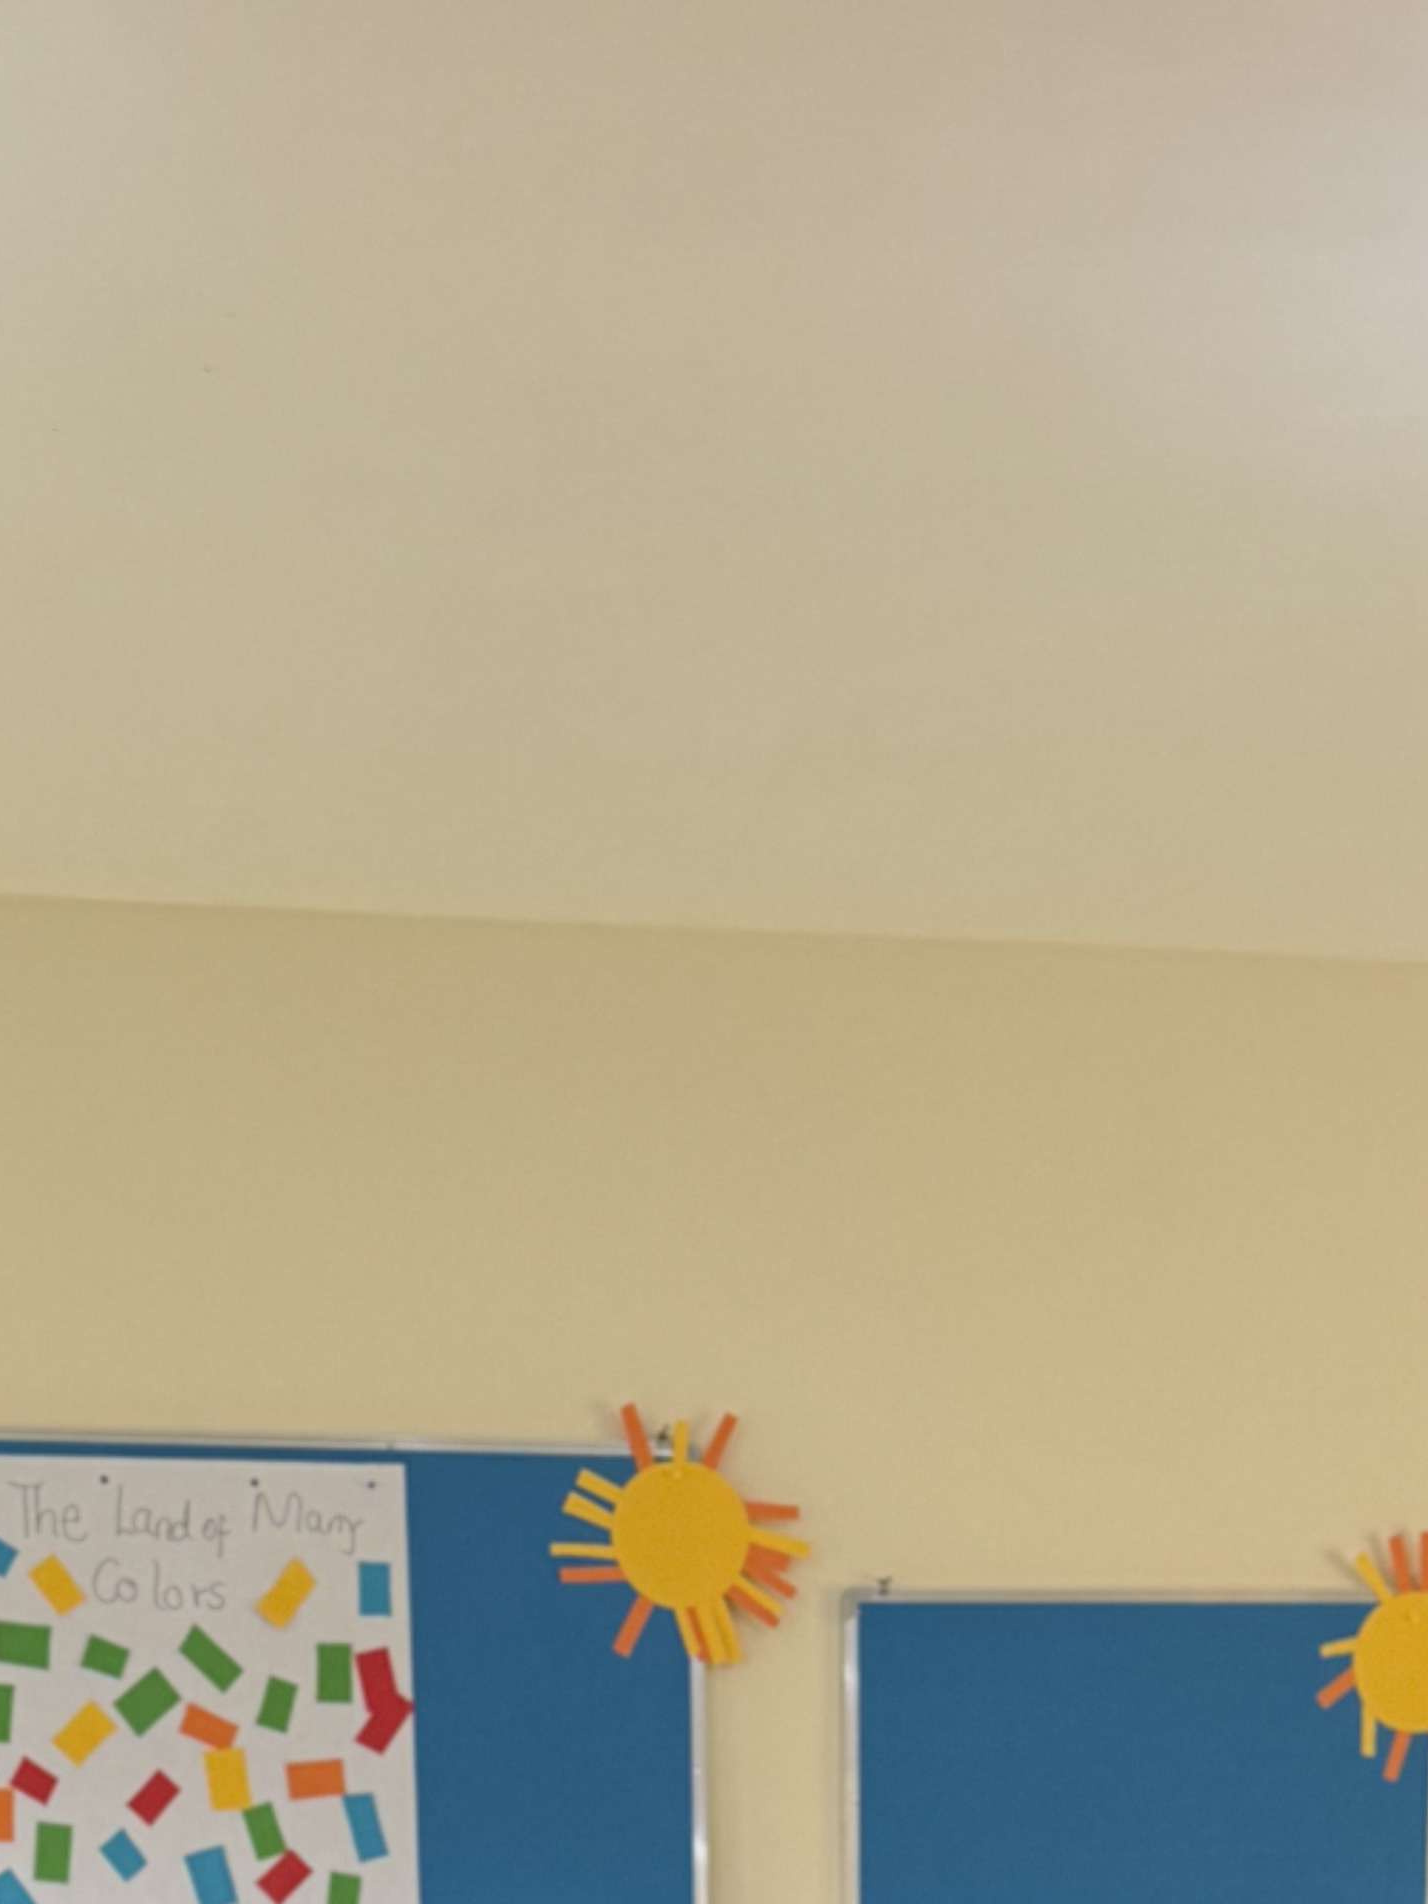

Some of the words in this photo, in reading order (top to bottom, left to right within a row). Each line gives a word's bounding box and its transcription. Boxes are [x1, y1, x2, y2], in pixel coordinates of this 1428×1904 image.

[6, 1480, 89, 1543] The
[114, 1484, 191, 1543] Land
[201, 1512, 233, 1558] of
[251, 1491, 363, 1556] Many
[91, 1557, 227, 1612] Colors
